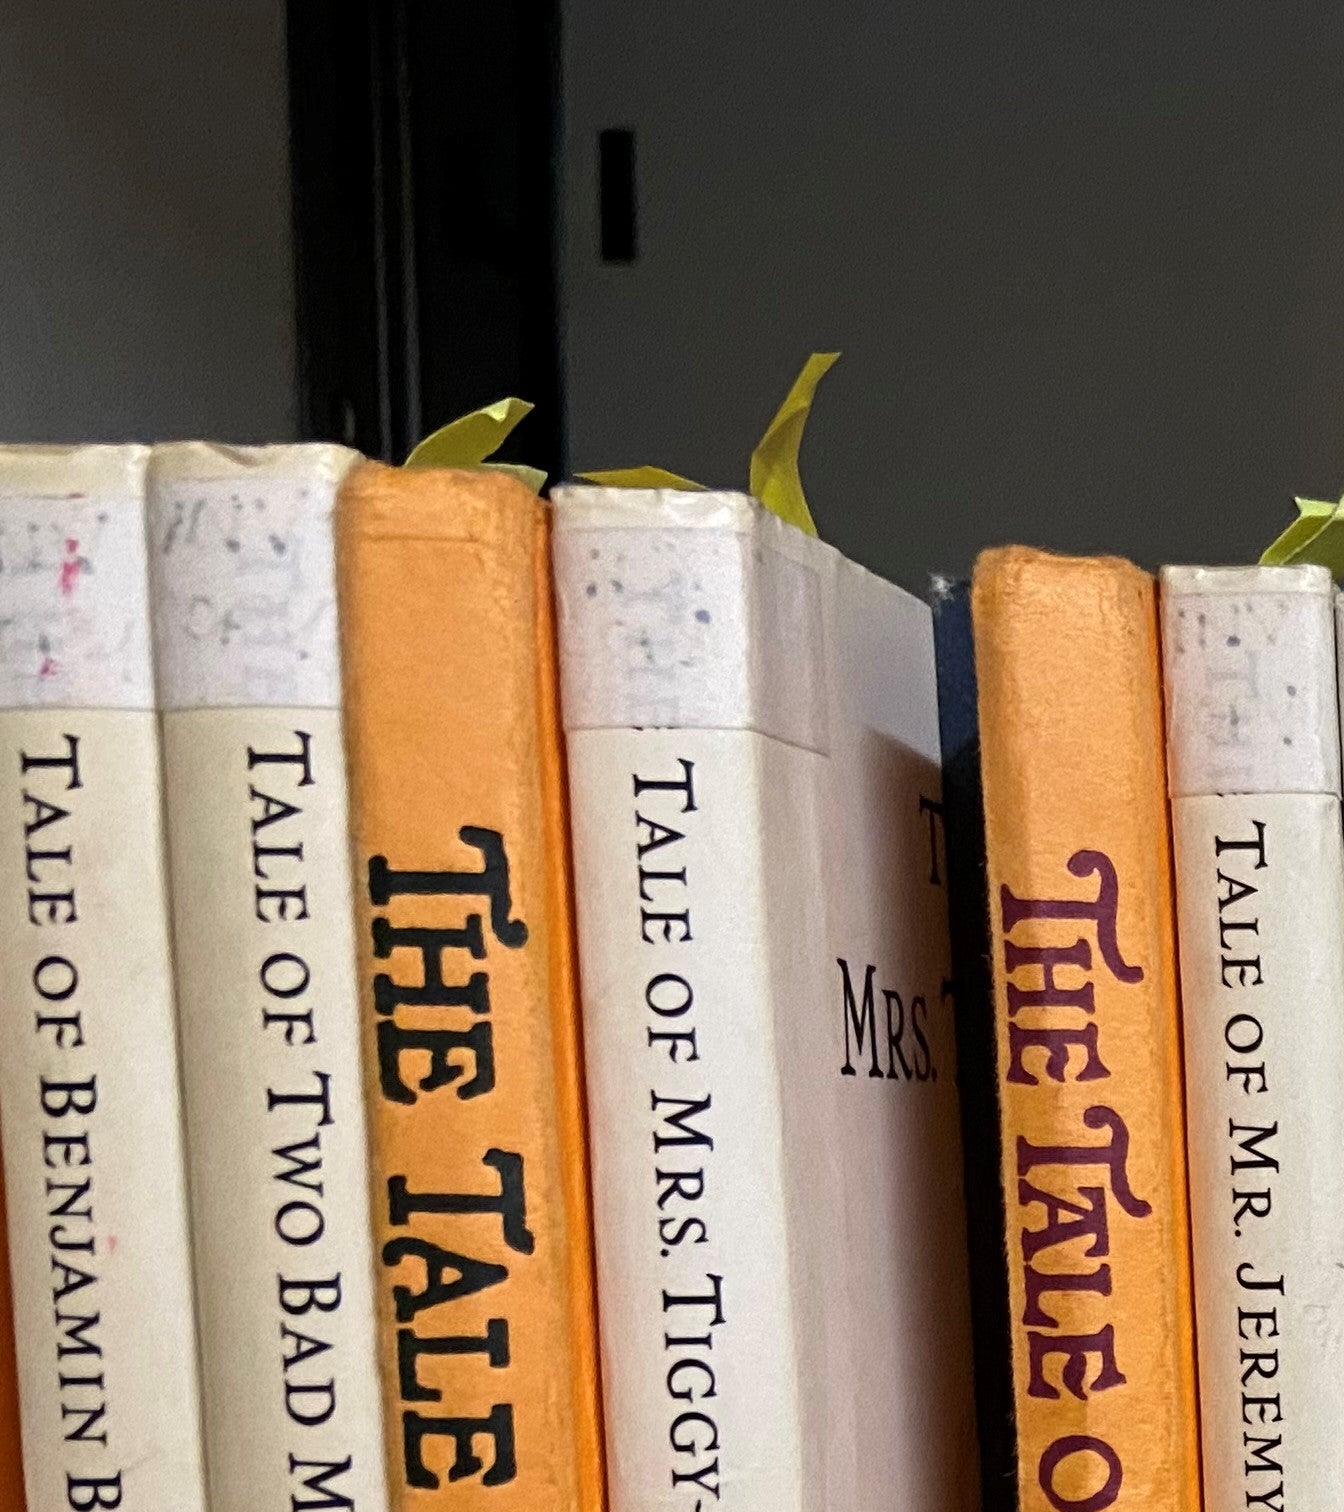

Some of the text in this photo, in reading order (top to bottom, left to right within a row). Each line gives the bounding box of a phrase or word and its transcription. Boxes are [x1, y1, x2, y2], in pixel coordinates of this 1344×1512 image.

[20, 734, 83, 927] TALE
[247, 731, 314, 924] TALE
[632, 757, 697, 944] TALE
[1214, 820, 1269, 991] TALE
[31, 955, 86, 1049] OF
[259, 952, 319, 1047] OF
[367, 825, 528, 1105] THE
[644, 973, 700, 1064] OF
[1000, 849, 1144, 1086] THE
[1224, 1012, 1269, 1095] OF
[267, 1070, 332, 1248] TWO
[651, 1089, 714, 1257] MRS.
[1227, 1117, 1279, 1238] MR.
[39, 1074, 108, 1446] BENJAMIN
[381, 1147, 535, 1491] TALE
[1014, 1104, 1152, 1401] TALE
[277, 1272, 342, 1427] BAD
